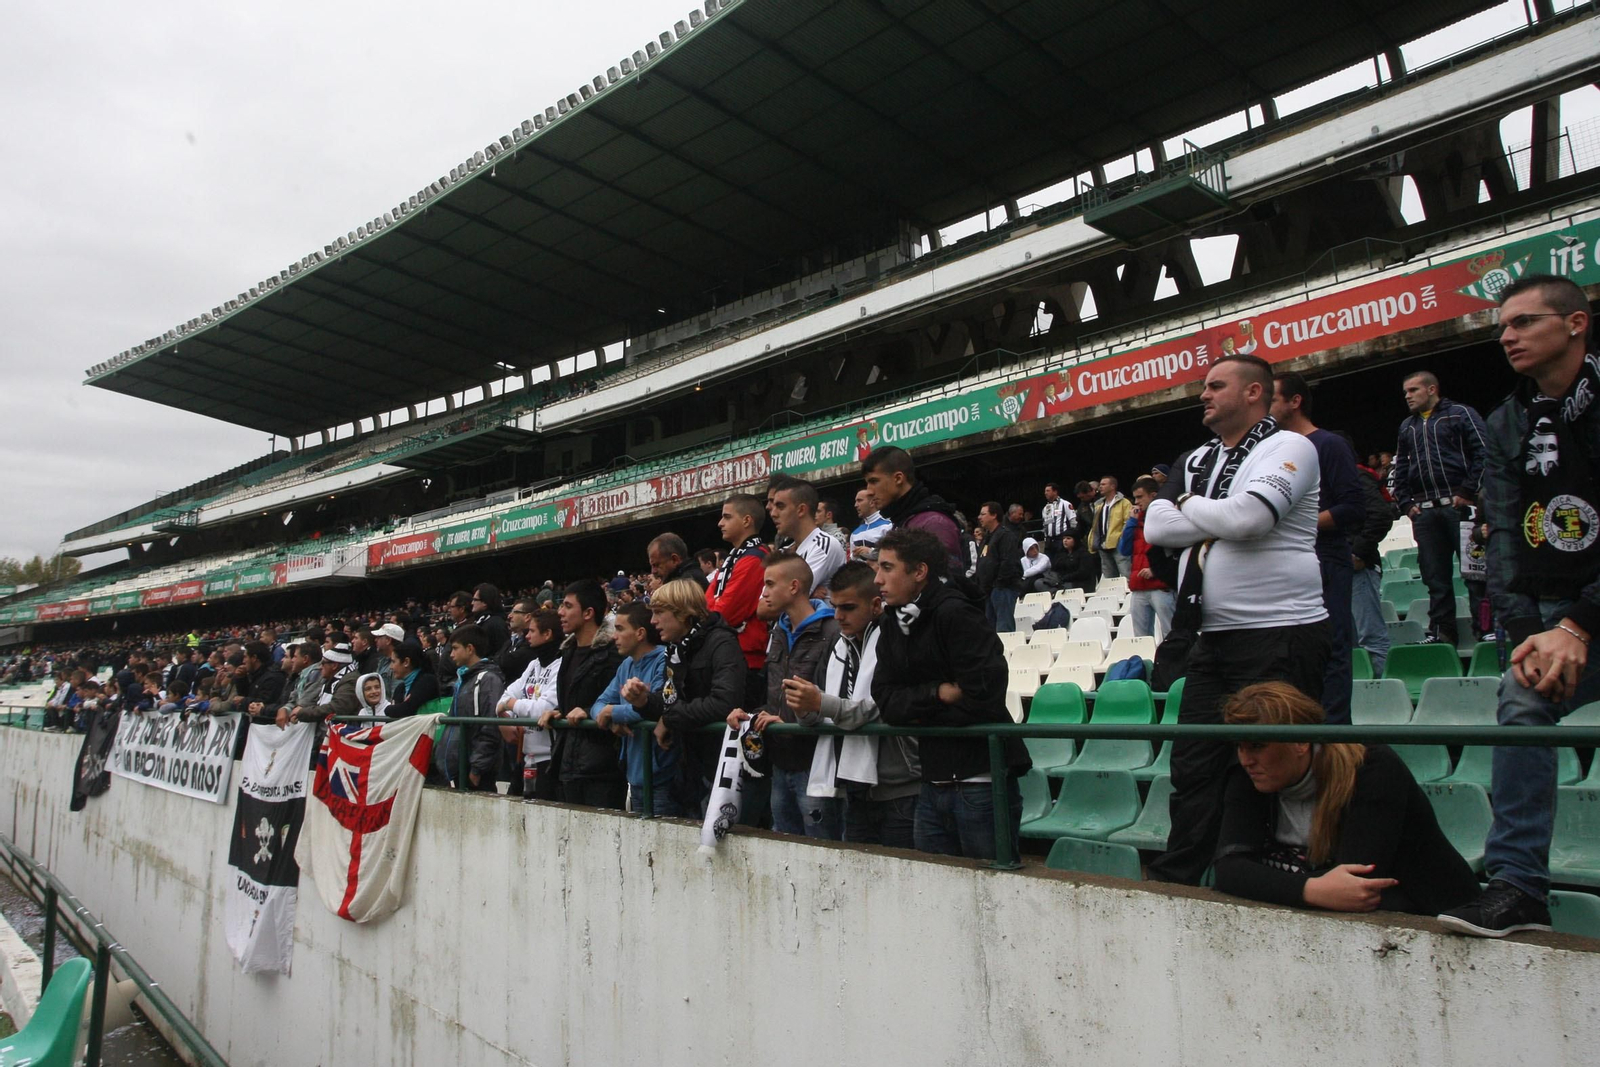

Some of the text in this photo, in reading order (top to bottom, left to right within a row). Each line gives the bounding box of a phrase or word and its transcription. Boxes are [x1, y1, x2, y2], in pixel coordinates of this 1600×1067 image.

[1420, 284, 1438, 310] SIN
[1263, 291, 1417, 349] Cruzcampo
[1195, 344, 1209, 367] SIN
[1077, 350, 1193, 396] Cruzcampo
[882, 406, 969, 443] Cruzcampo
[971, 402, 980, 421] SIN
[785, 444, 817, 469] QUIERO,
[819, 436, 849, 460] BETIS!
[502, 514, 543, 533] Cruzcampo
[392, 540, 424, 556] Cruzcampo
[1468, 563, 1486, 572] 1912
[206, 719, 236, 758] POR
[167, 757, 189, 787] 100
